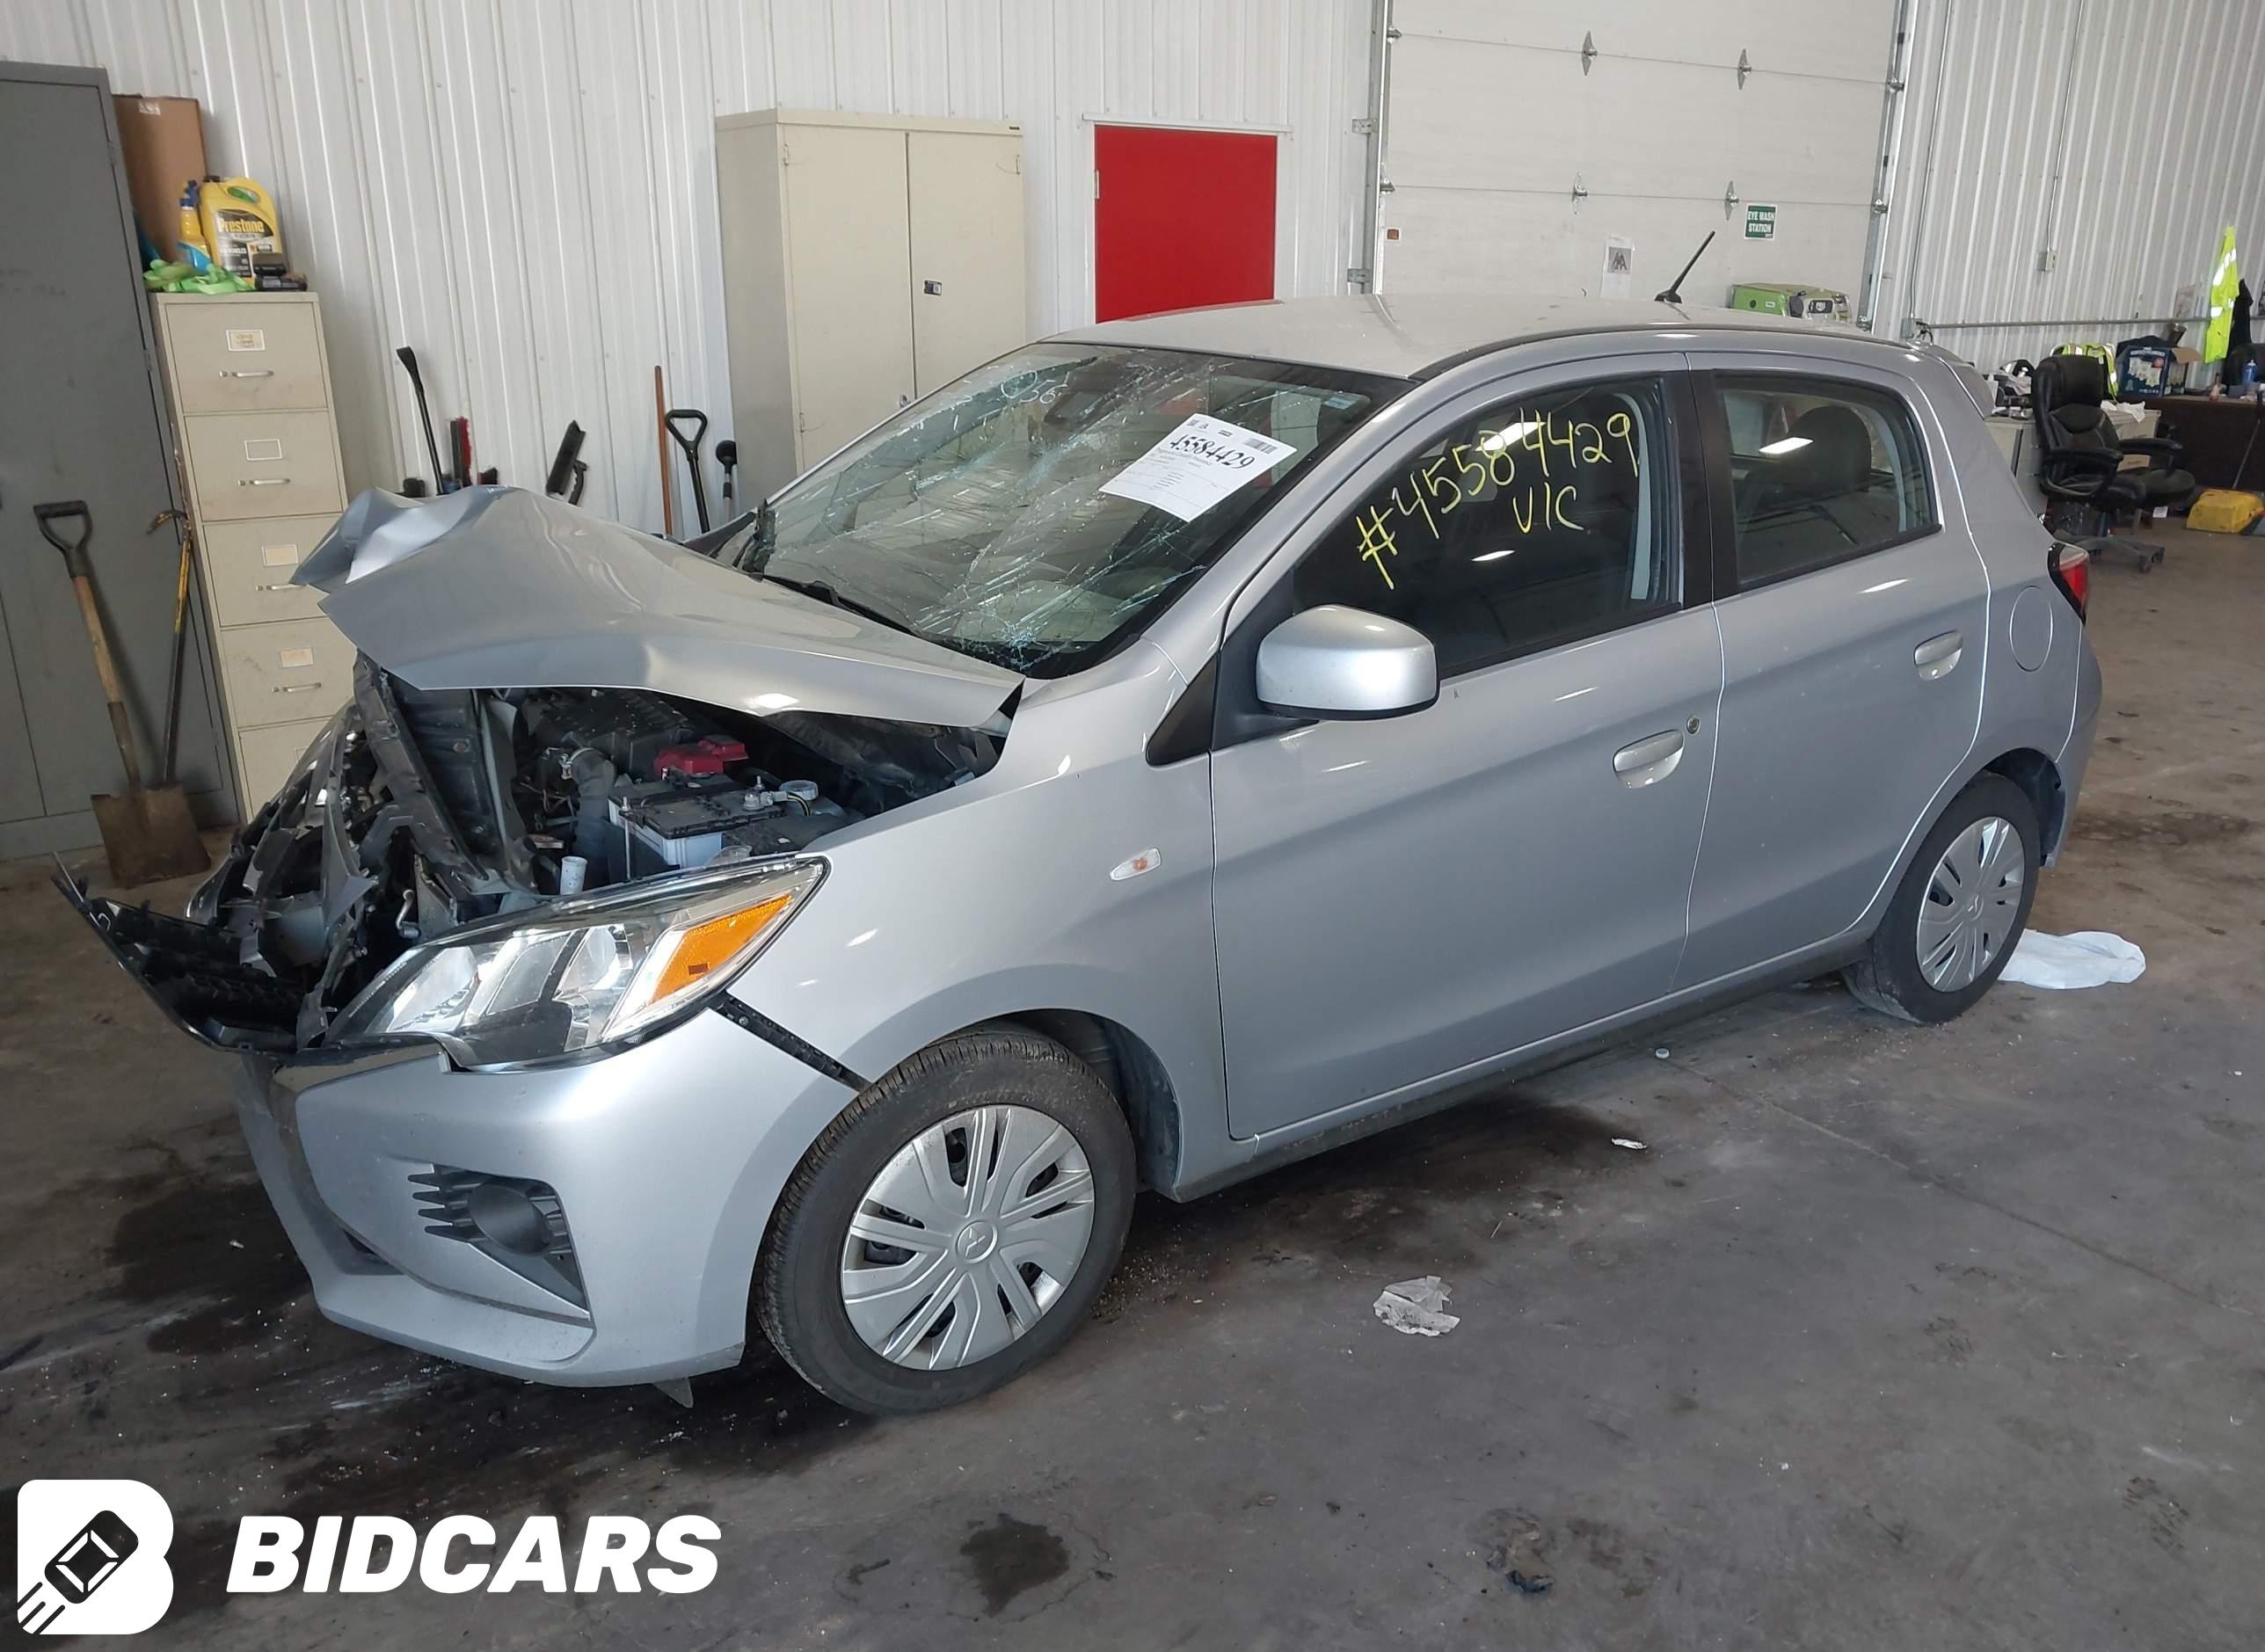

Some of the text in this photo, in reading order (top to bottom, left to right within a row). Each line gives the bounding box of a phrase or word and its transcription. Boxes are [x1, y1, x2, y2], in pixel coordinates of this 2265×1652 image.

[1748, 211, 1775, 221] EYE WASH
[217, 217, 266, 232] Prestone
[1748, 223, 1772, 232] STATION
[1170, 434, 1256, 469] 45584429
